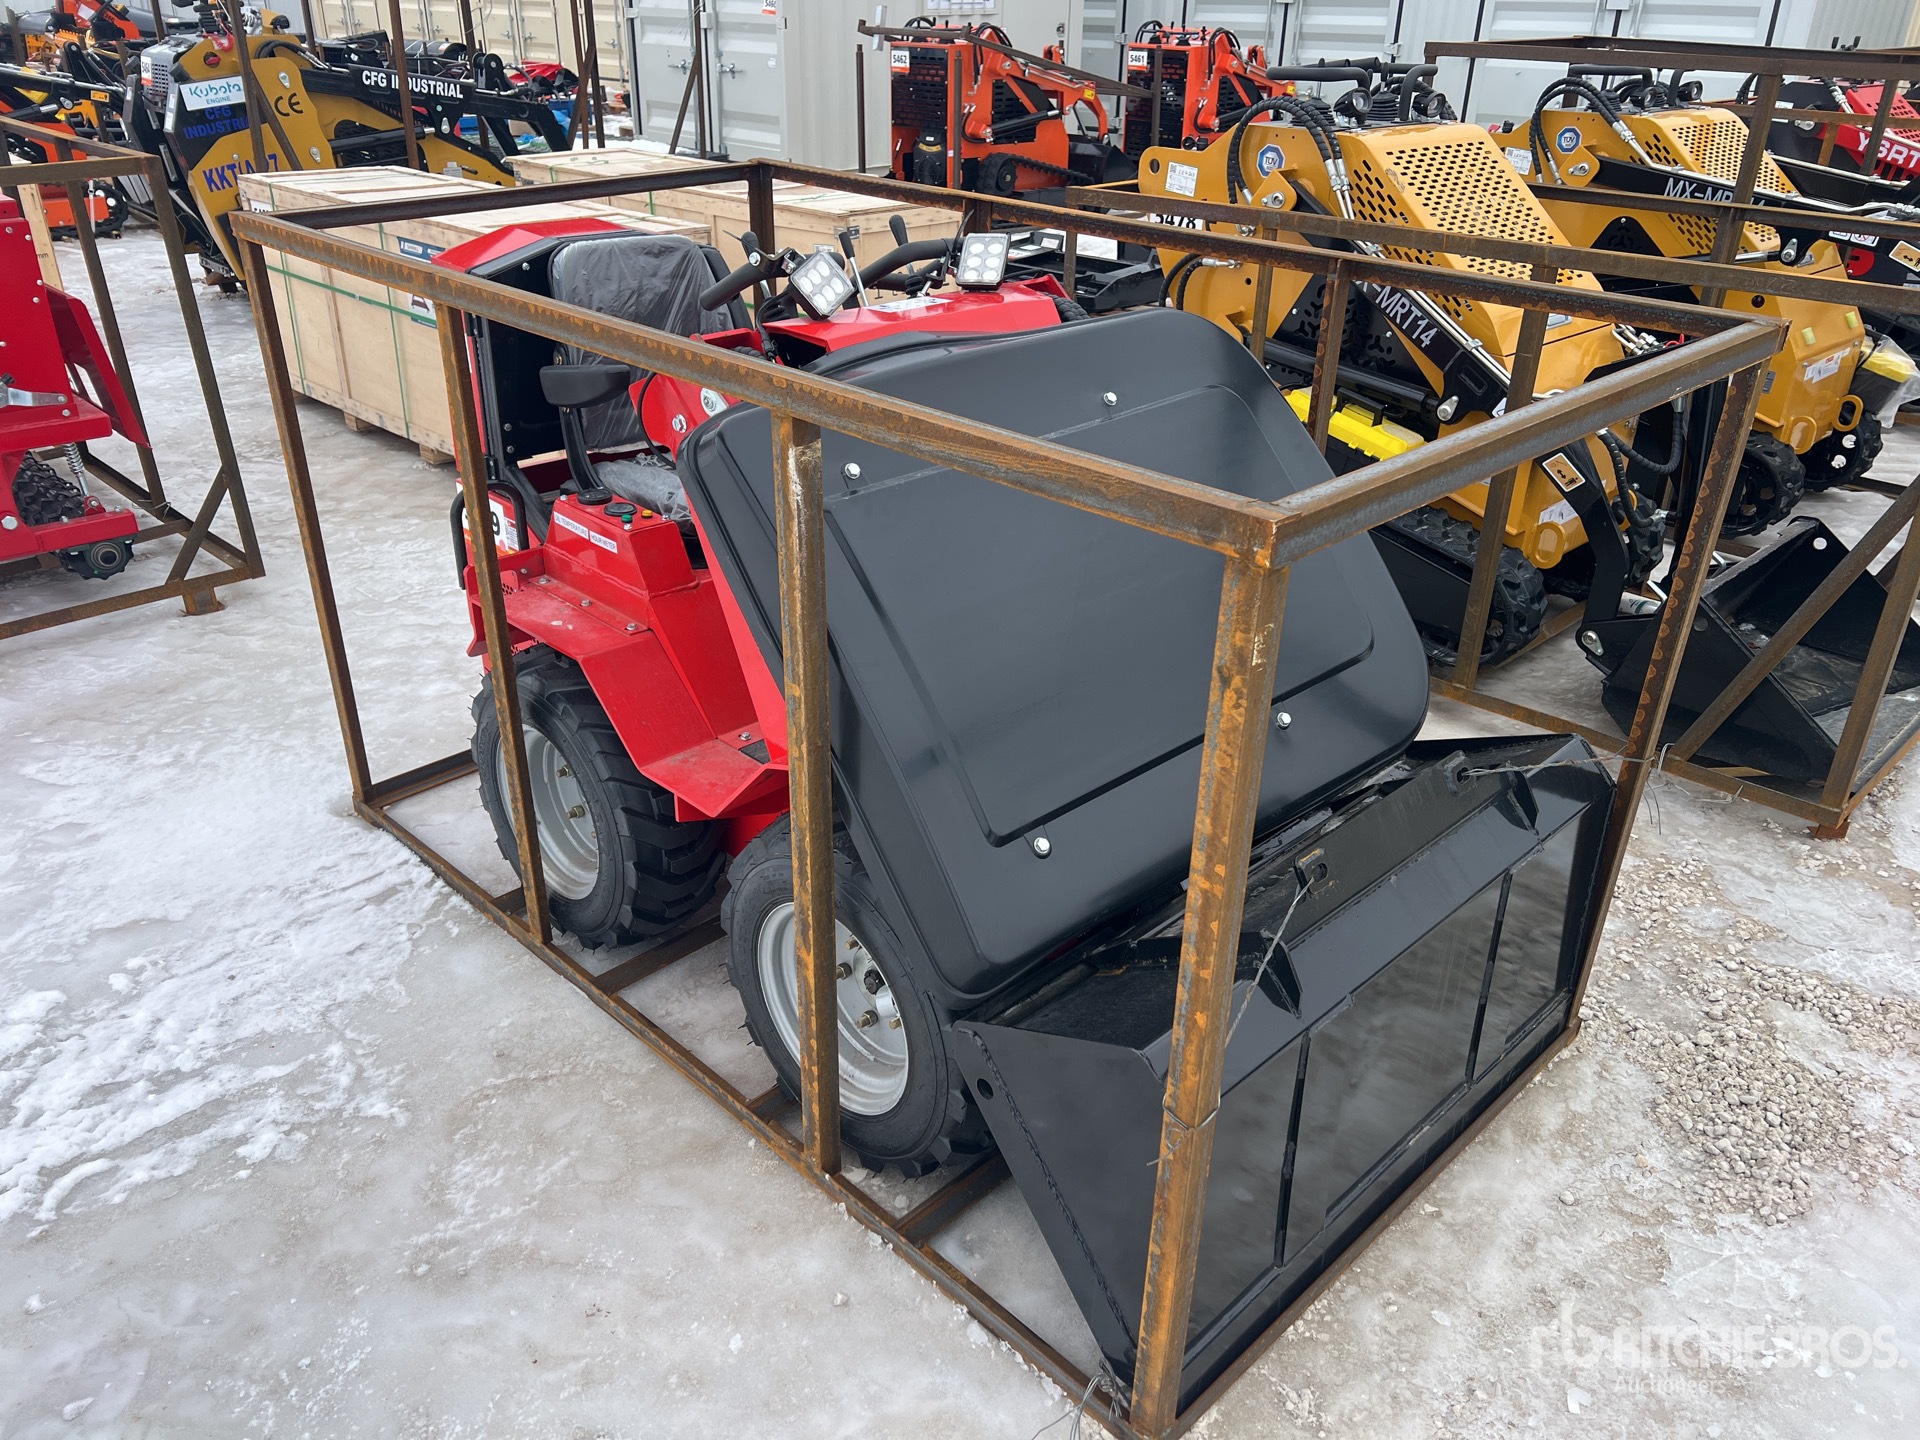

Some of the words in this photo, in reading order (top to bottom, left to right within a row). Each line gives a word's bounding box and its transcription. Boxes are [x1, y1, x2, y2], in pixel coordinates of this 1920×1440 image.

[892, 54, 907, 64] 5462
[1130, 54, 1145, 63] 5461
[189, 81, 242, 98] Kubota
[362, 70, 387, 87] CFG
[391, 74, 464, 99] IDUSTRIAL
[206, 95, 232, 104] ENGINE
[204, 105, 232, 120] CFG
[183, 115, 249, 139] INDUSTRI
[1352, 280, 1438, 348] -MRT14
